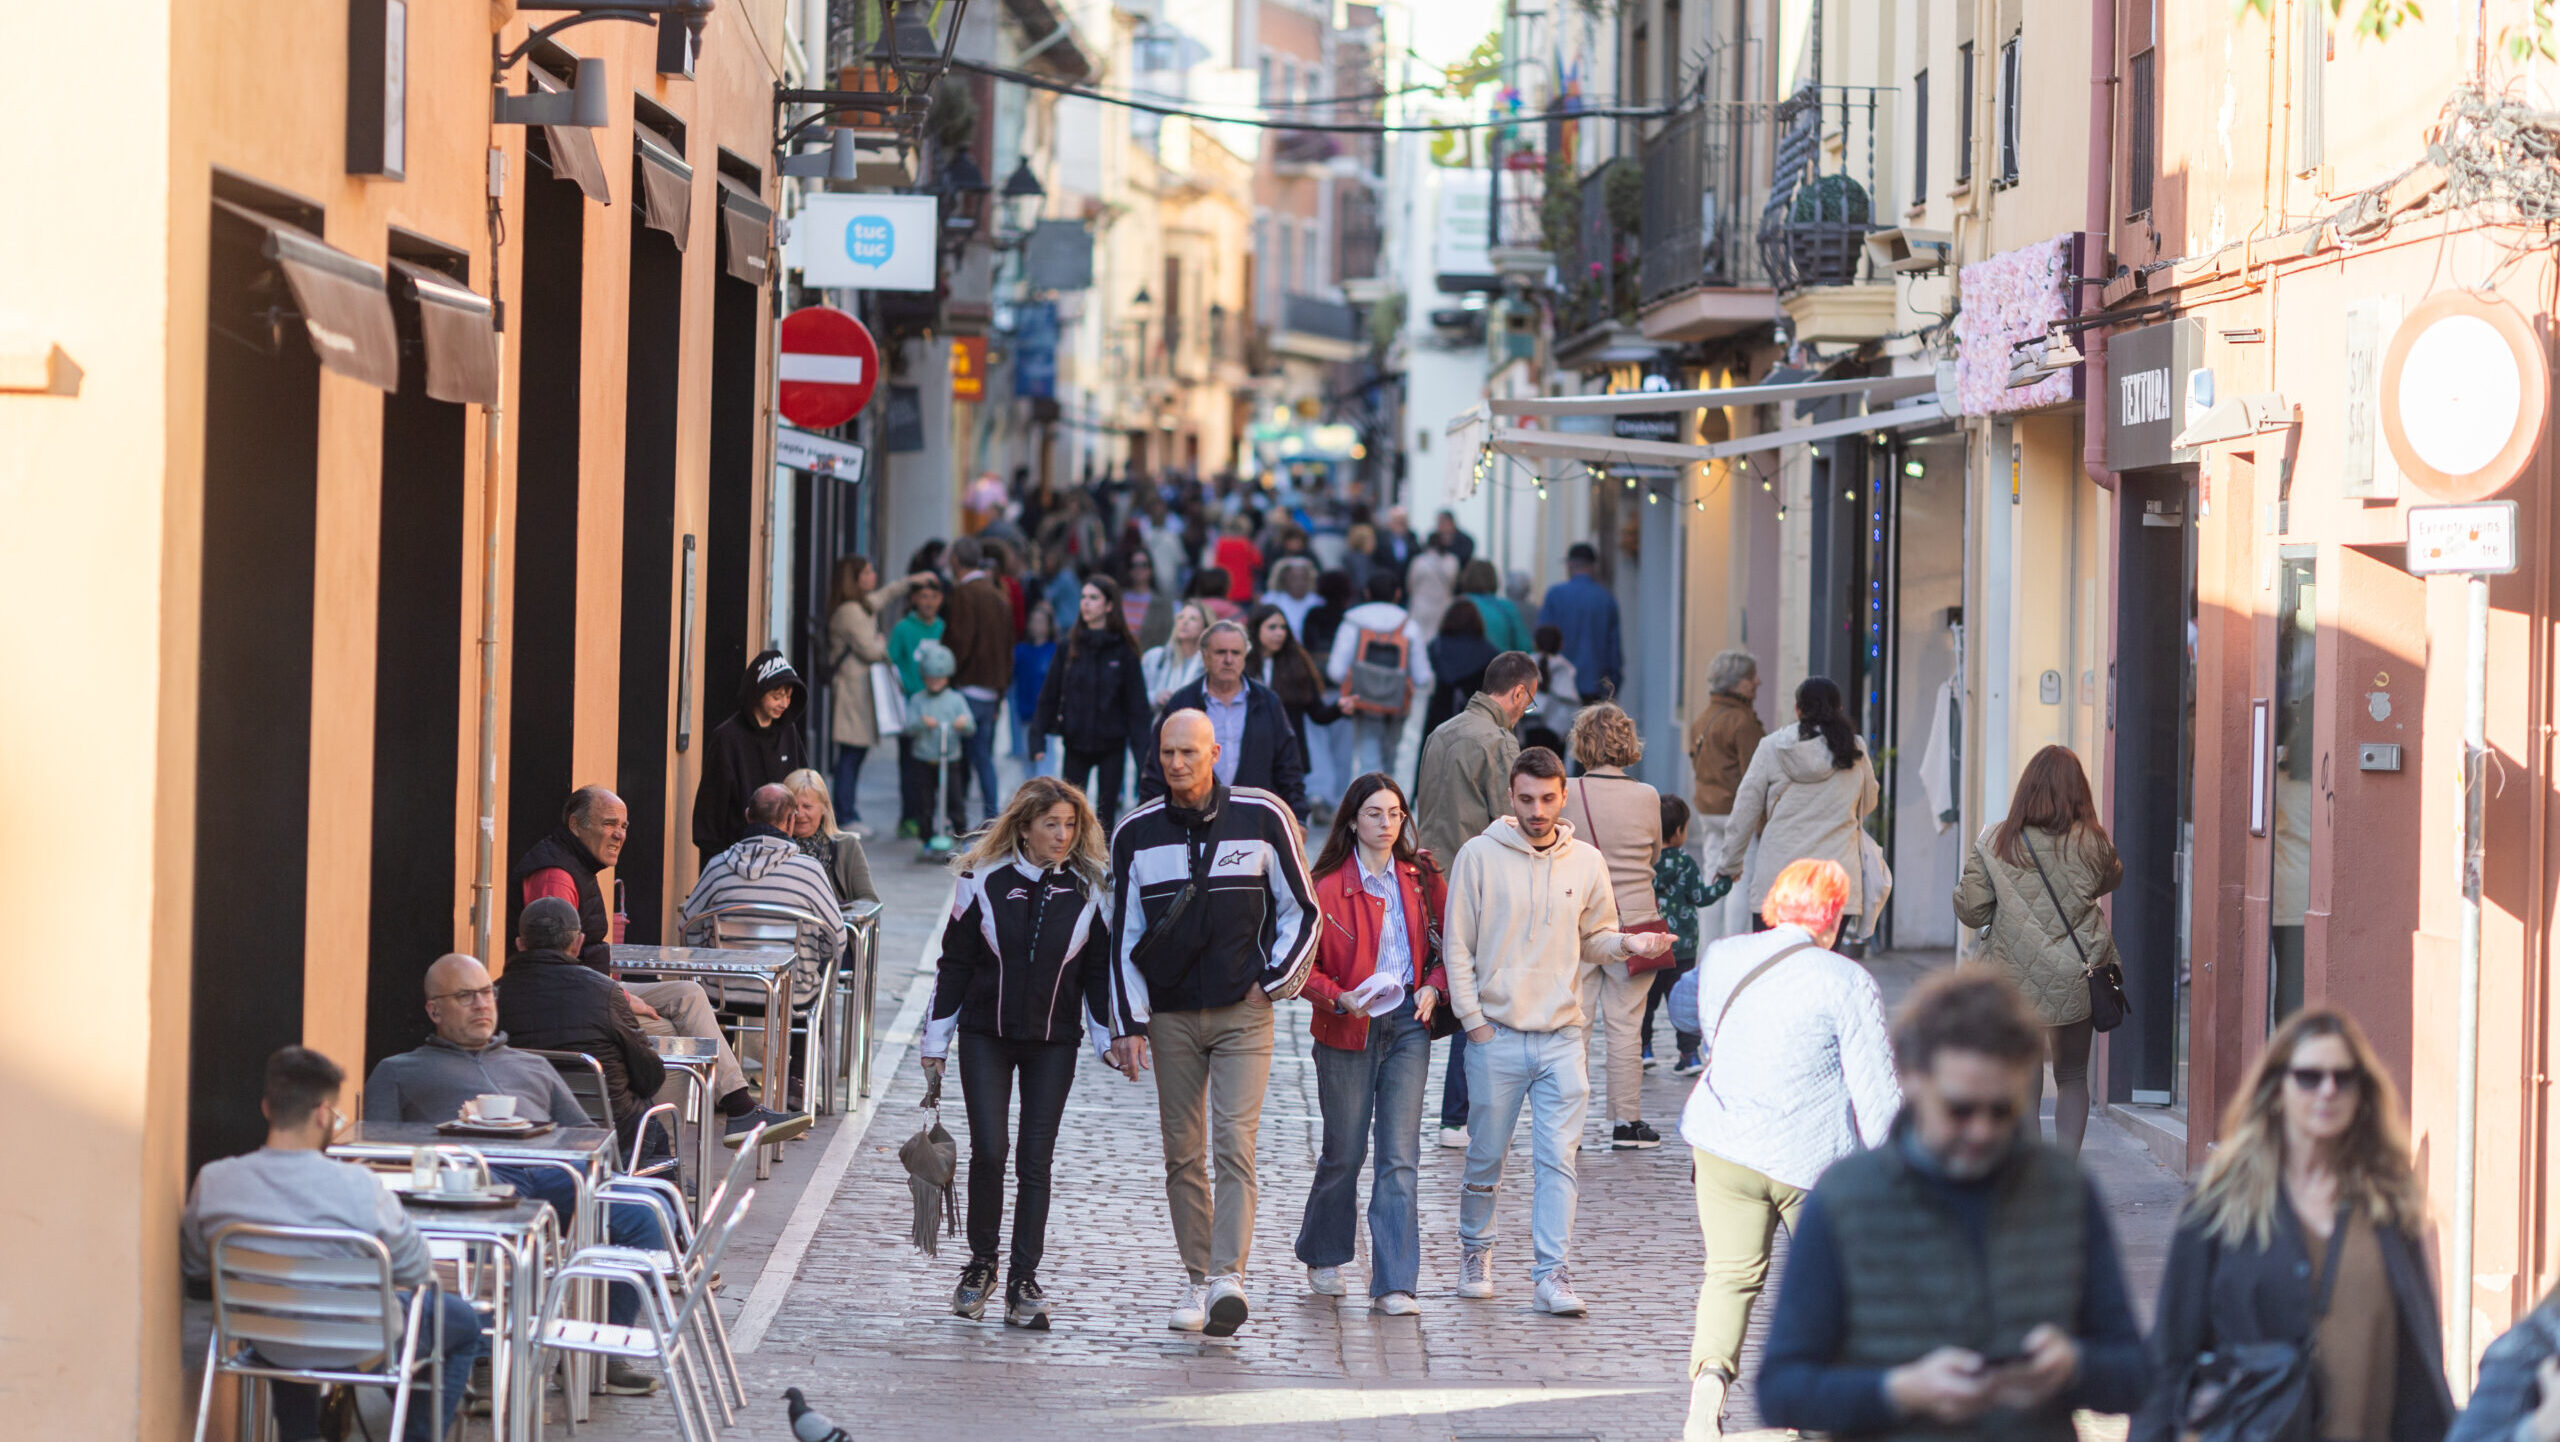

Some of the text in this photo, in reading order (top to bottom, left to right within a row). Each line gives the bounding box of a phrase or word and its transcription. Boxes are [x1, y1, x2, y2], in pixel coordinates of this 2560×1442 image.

[854, 223, 887, 239] tuc
[854, 241, 887, 257] tuc
[2120, 368, 2170, 426] TEXTURA
